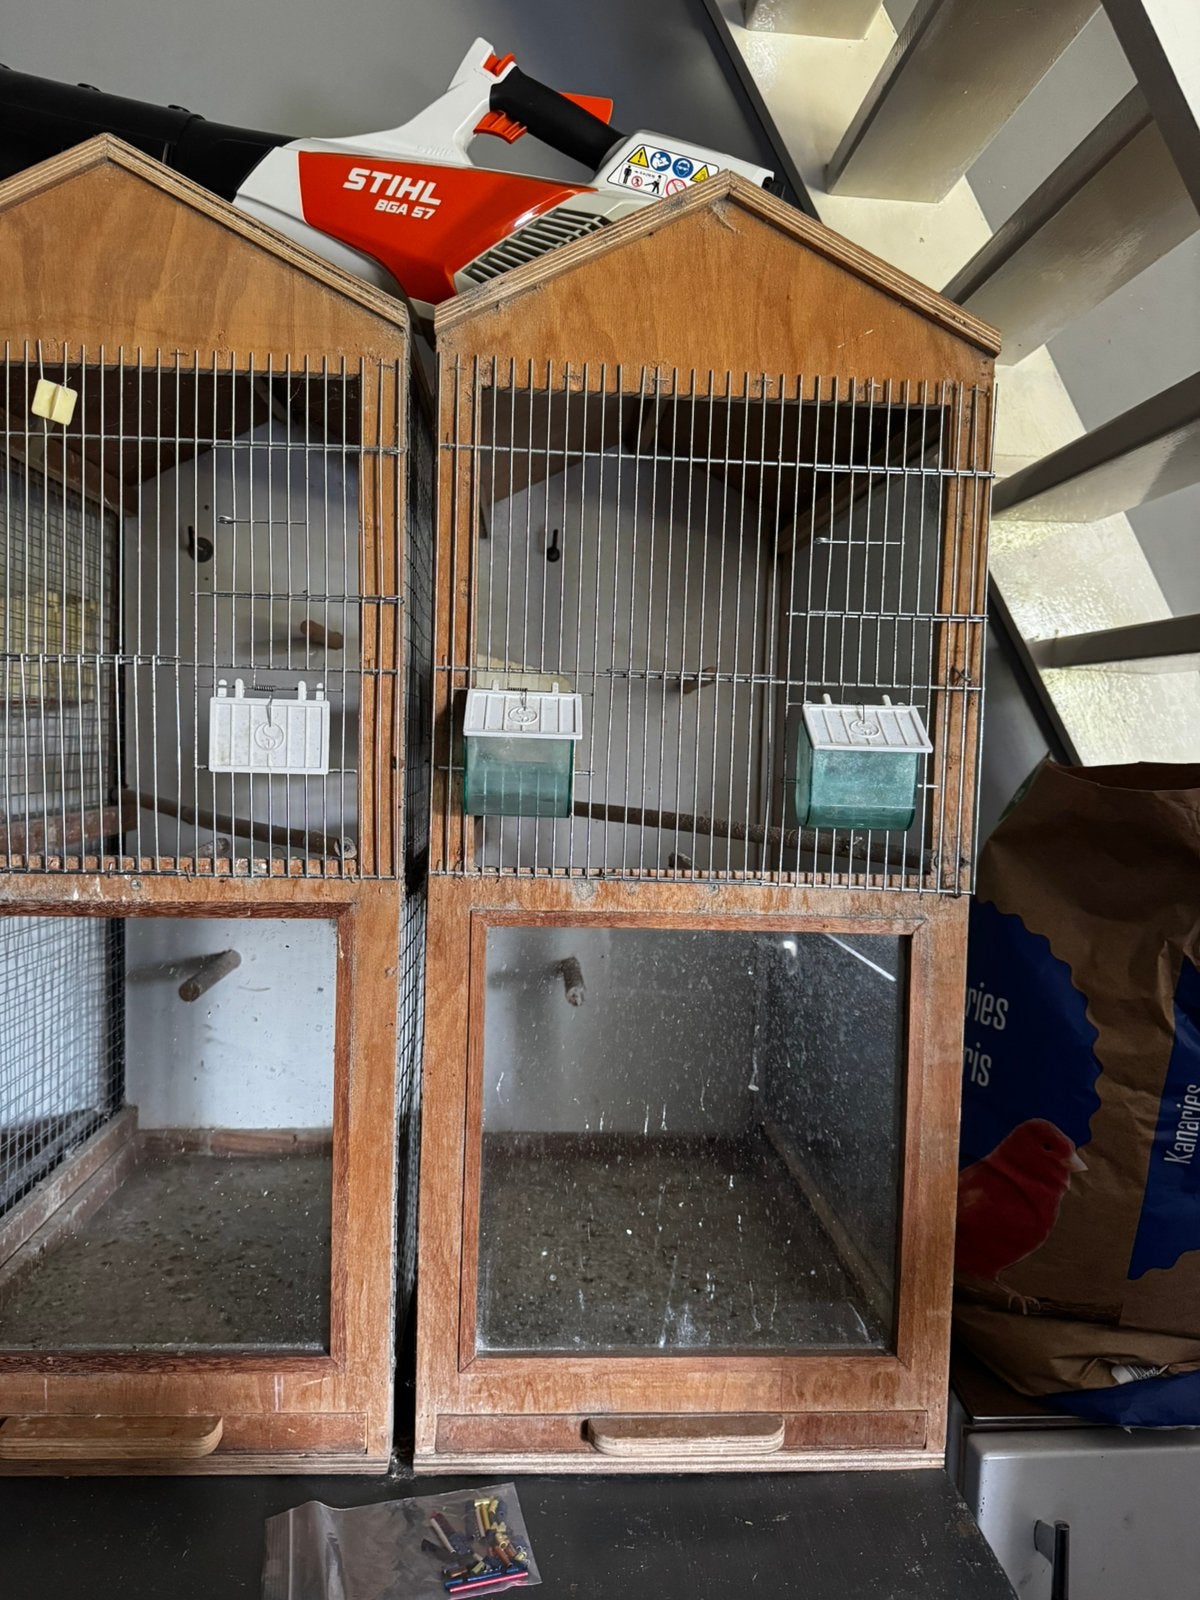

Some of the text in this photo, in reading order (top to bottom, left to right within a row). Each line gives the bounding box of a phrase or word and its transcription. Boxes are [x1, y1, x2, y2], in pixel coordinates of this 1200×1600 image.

[342, 167, 442, 206] STIHL
[374, 198, 436, 220] BGA 57
